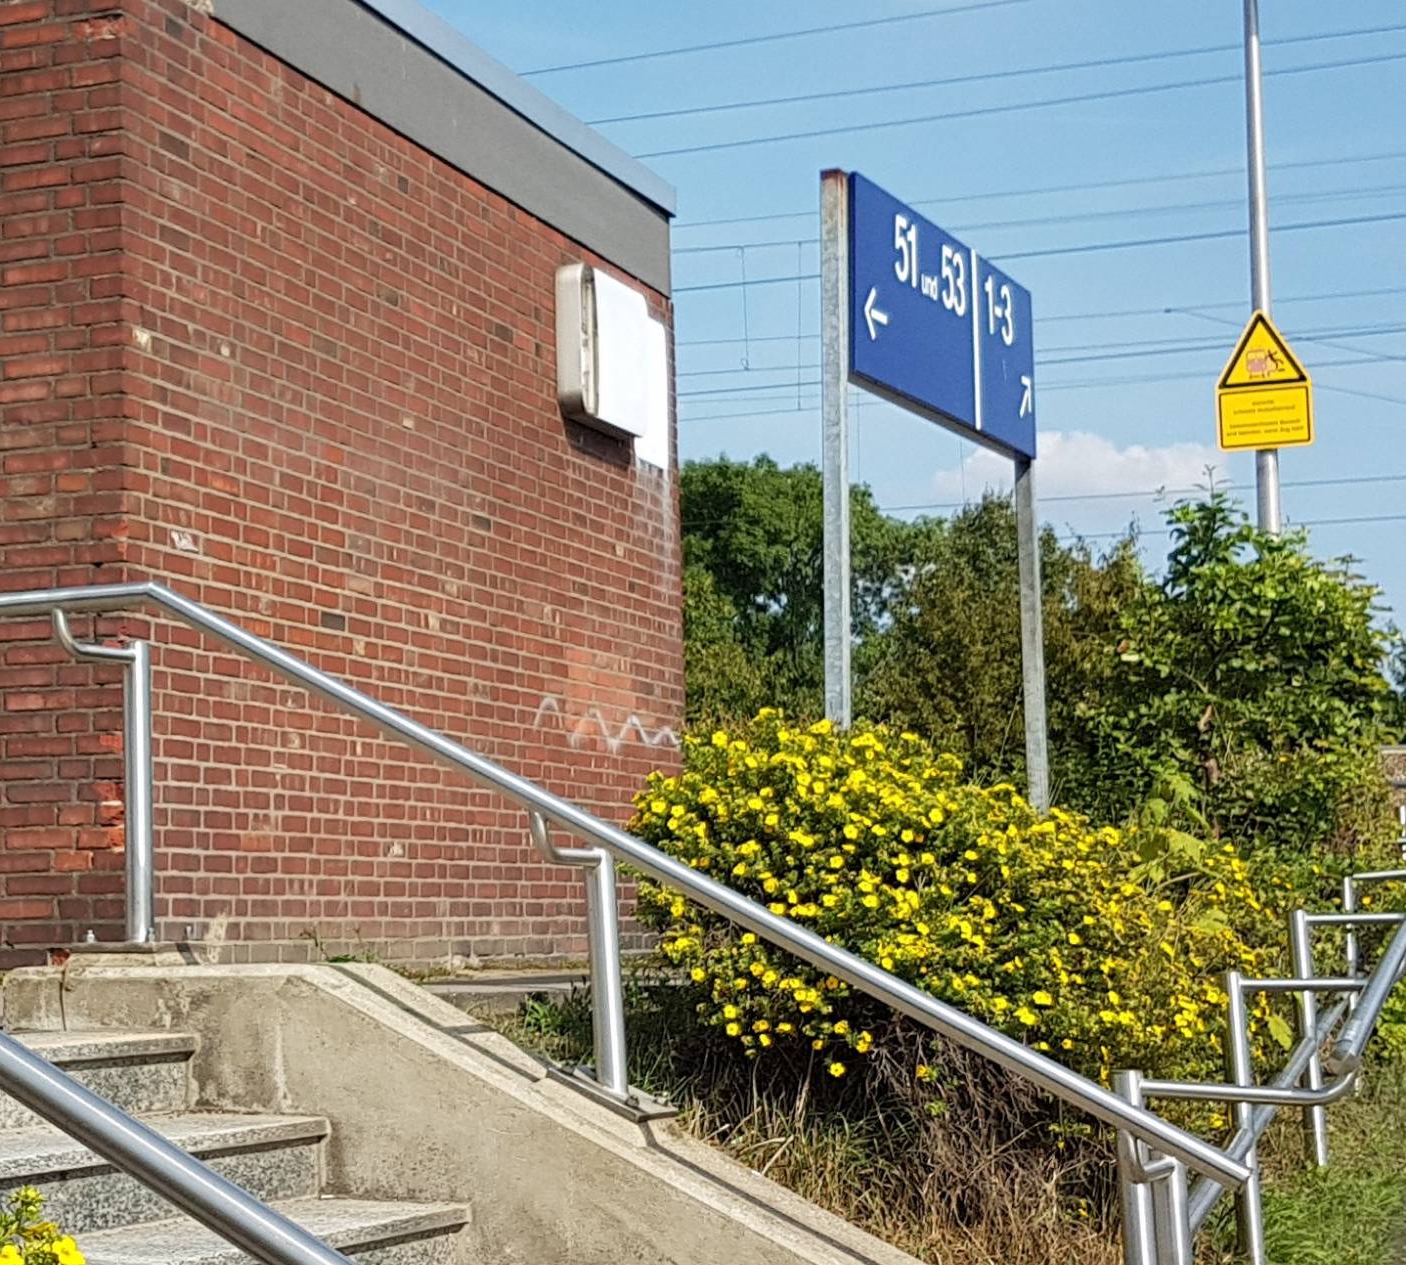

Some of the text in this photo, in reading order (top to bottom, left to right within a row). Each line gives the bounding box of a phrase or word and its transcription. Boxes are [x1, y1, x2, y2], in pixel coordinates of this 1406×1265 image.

[894, 213, 966, 317] 51 und 53
[984, 274, 1015, 346] 1-3
